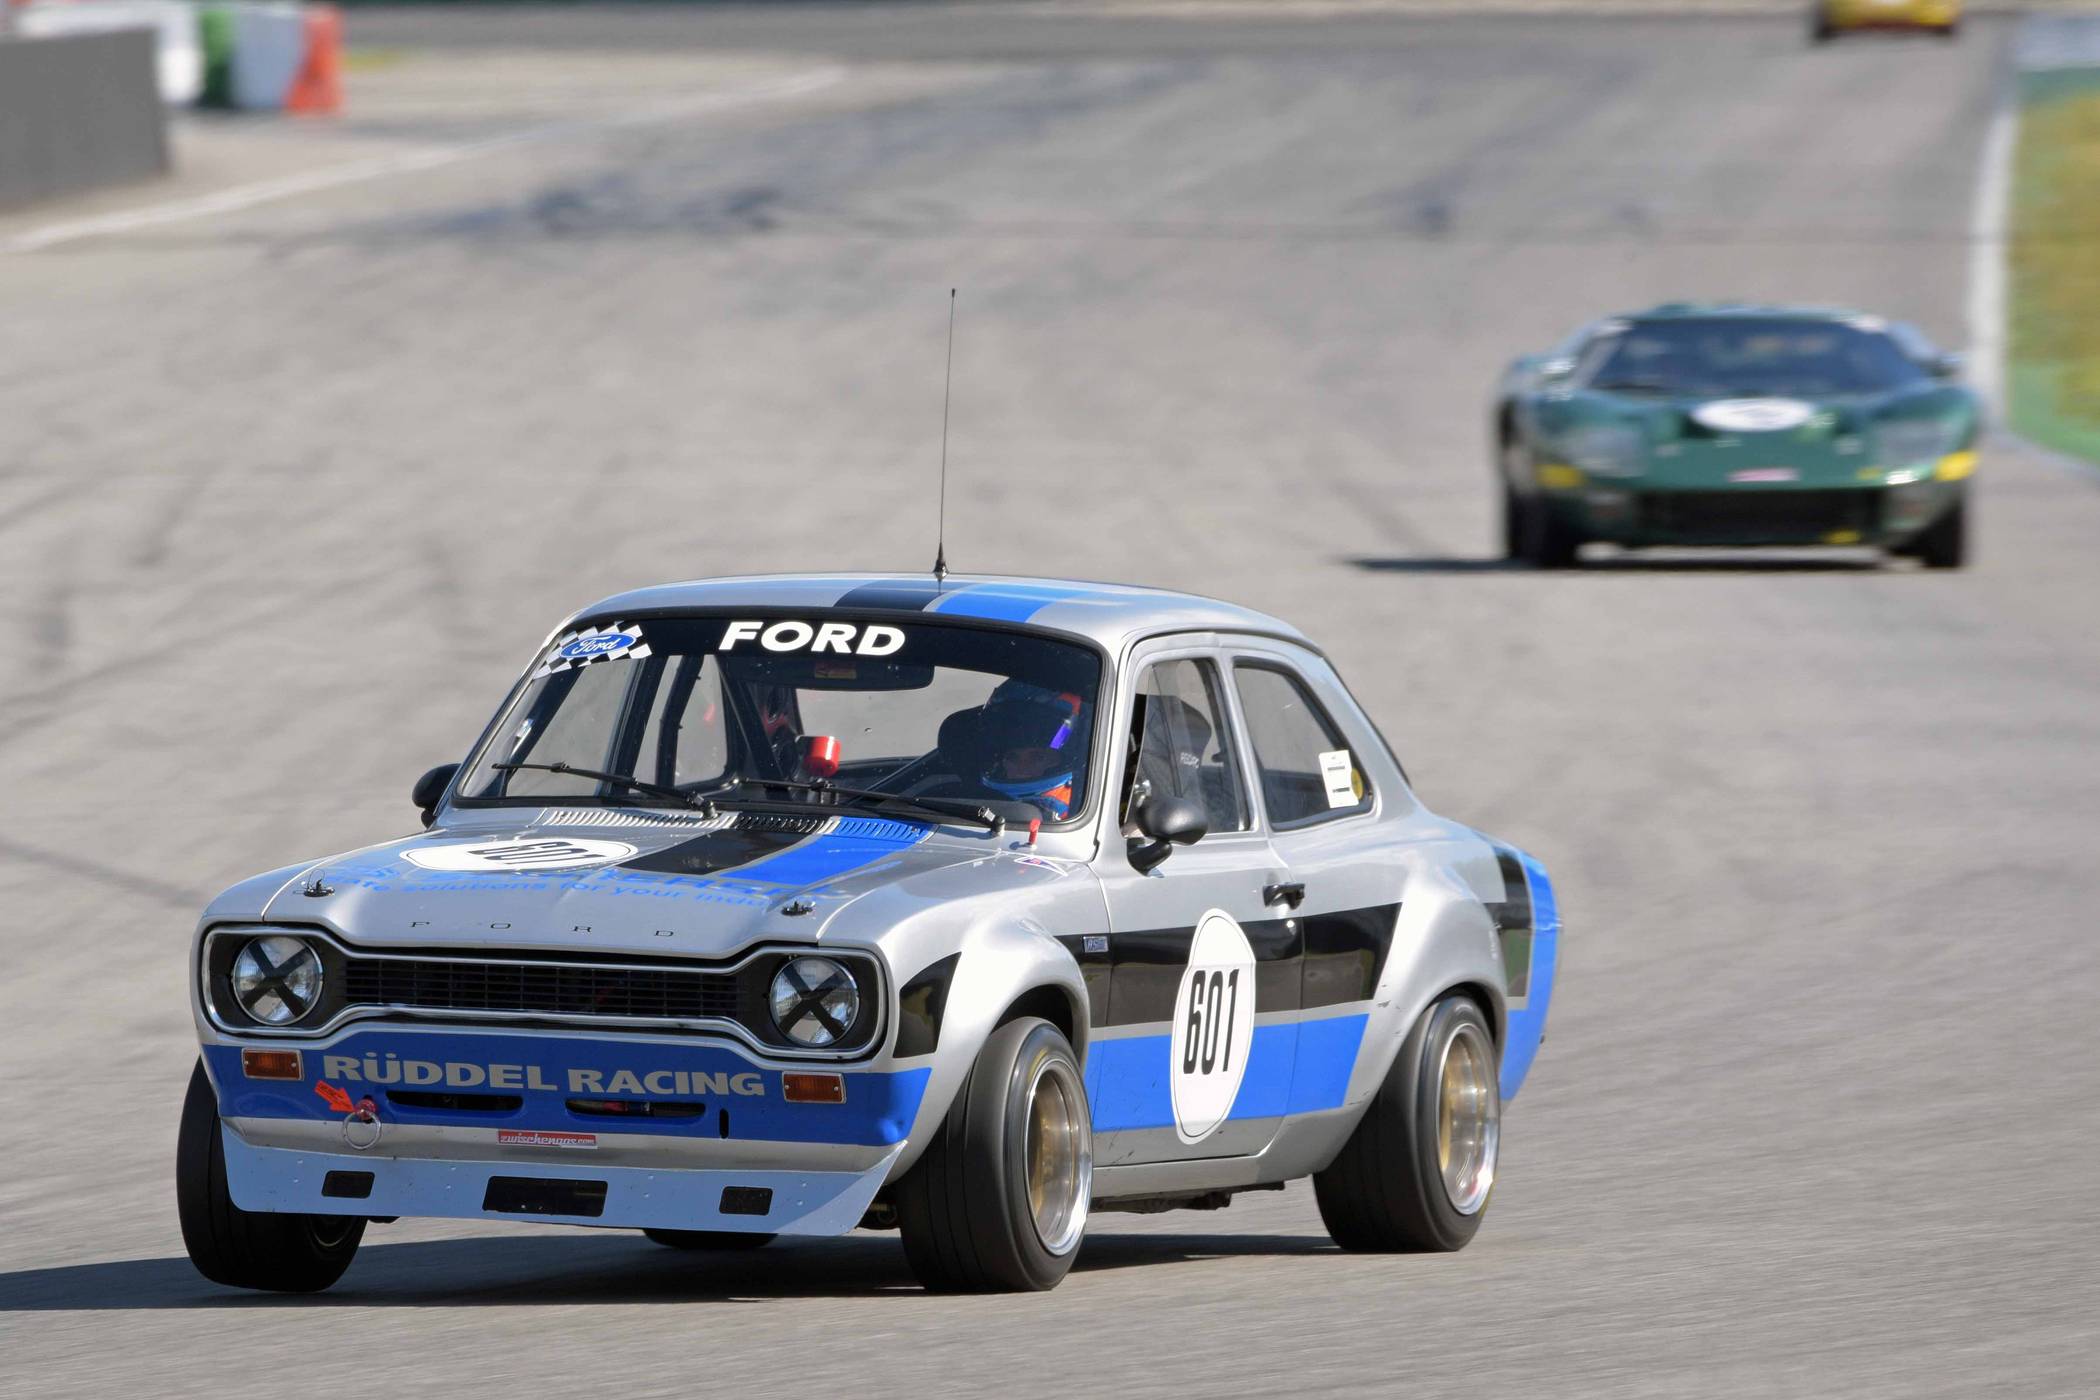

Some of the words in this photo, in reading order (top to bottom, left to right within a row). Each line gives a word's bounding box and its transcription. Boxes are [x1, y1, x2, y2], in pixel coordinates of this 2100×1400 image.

[571, 635, 622, 655] Ford
[718, 621, 906, 657] FORD
[467, 841, 607, 865] 601
[559, 880, 605, 892] for
[613, 884, 685, 899] your
[411, 920, 675, 937] FORD
[1183, 968, 1240, 1075] 601
[323, 1052, 558, 1091] RÜDDEL
[567, 1068, 765, 1096] RACING
